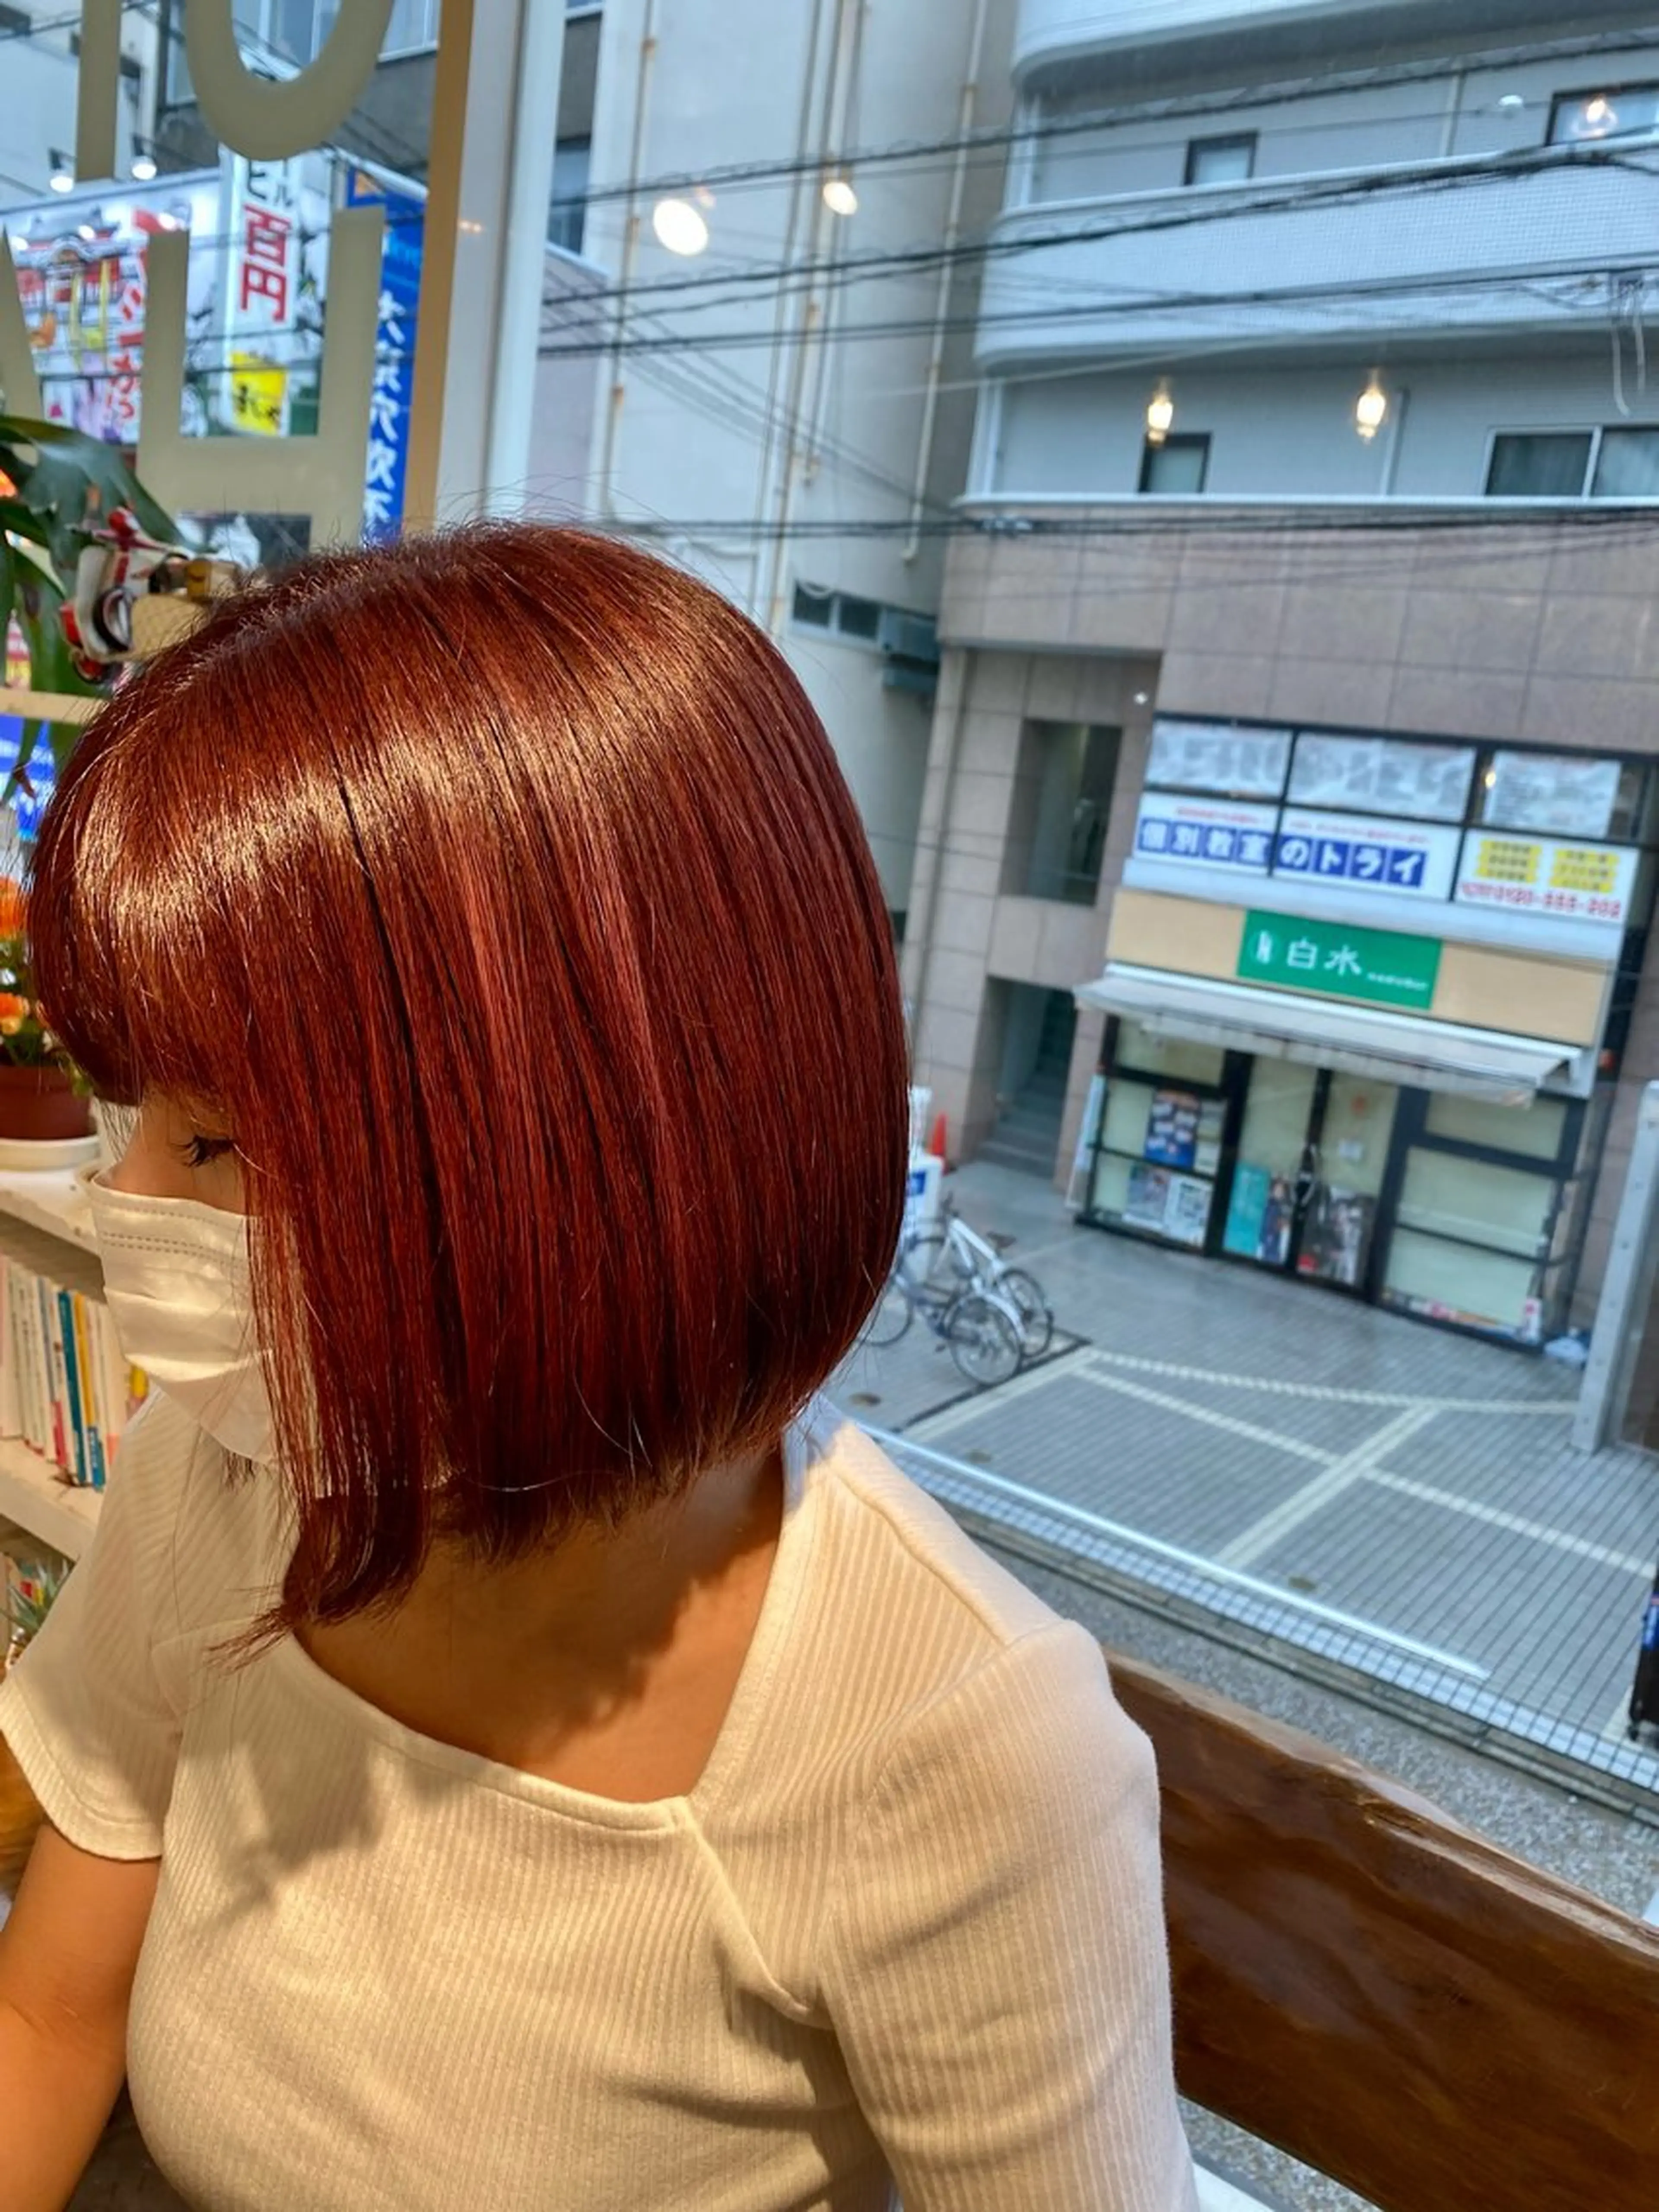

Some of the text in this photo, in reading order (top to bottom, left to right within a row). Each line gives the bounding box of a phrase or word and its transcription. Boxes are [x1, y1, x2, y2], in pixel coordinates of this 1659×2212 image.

[1141, 820, 1422, 884] 個別教室のトライ
[1286, 937, 1363, 977] 白水
